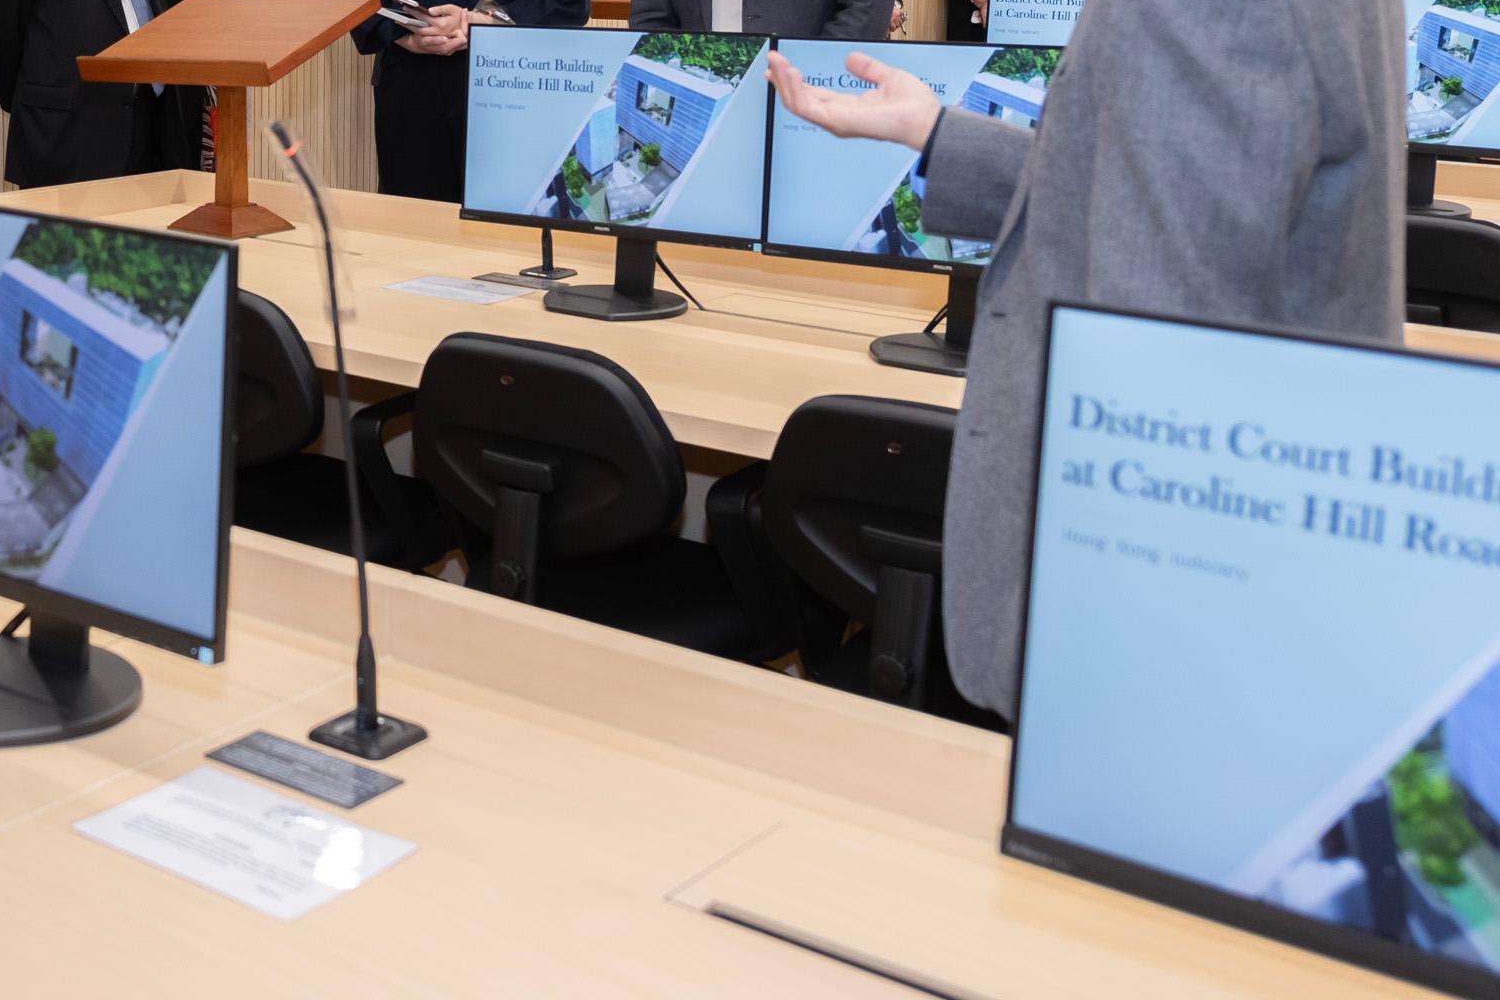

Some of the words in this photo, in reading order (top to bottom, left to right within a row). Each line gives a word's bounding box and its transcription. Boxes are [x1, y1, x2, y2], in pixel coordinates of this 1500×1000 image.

[993, 9, 1003, 18] at
[1005, 8, 1048, 20] Caroline
[1051, 10, 1071, 21] Hill
[475, 54, 515, 69] District
[518, 56, 551, 71] Court
[554, 58, 605, 76] Building
[474, 77, 484, 87] at
[487, 74, 535, 90] Caroline
[537, 77, 560, 91] Hill
[563, 79, 594, 93] Road
[1068, 391, 1213, 454] District
[1226, 420, 1351, 478] Court
[1368, 443, 1500, 505] Build
[1060, 456, 1096, 490] at
[1109, 455, 1287, 528] Caroline
[1298, 492, 1388, 547] Hill
[1402, 511, 1500, 569] Roa
